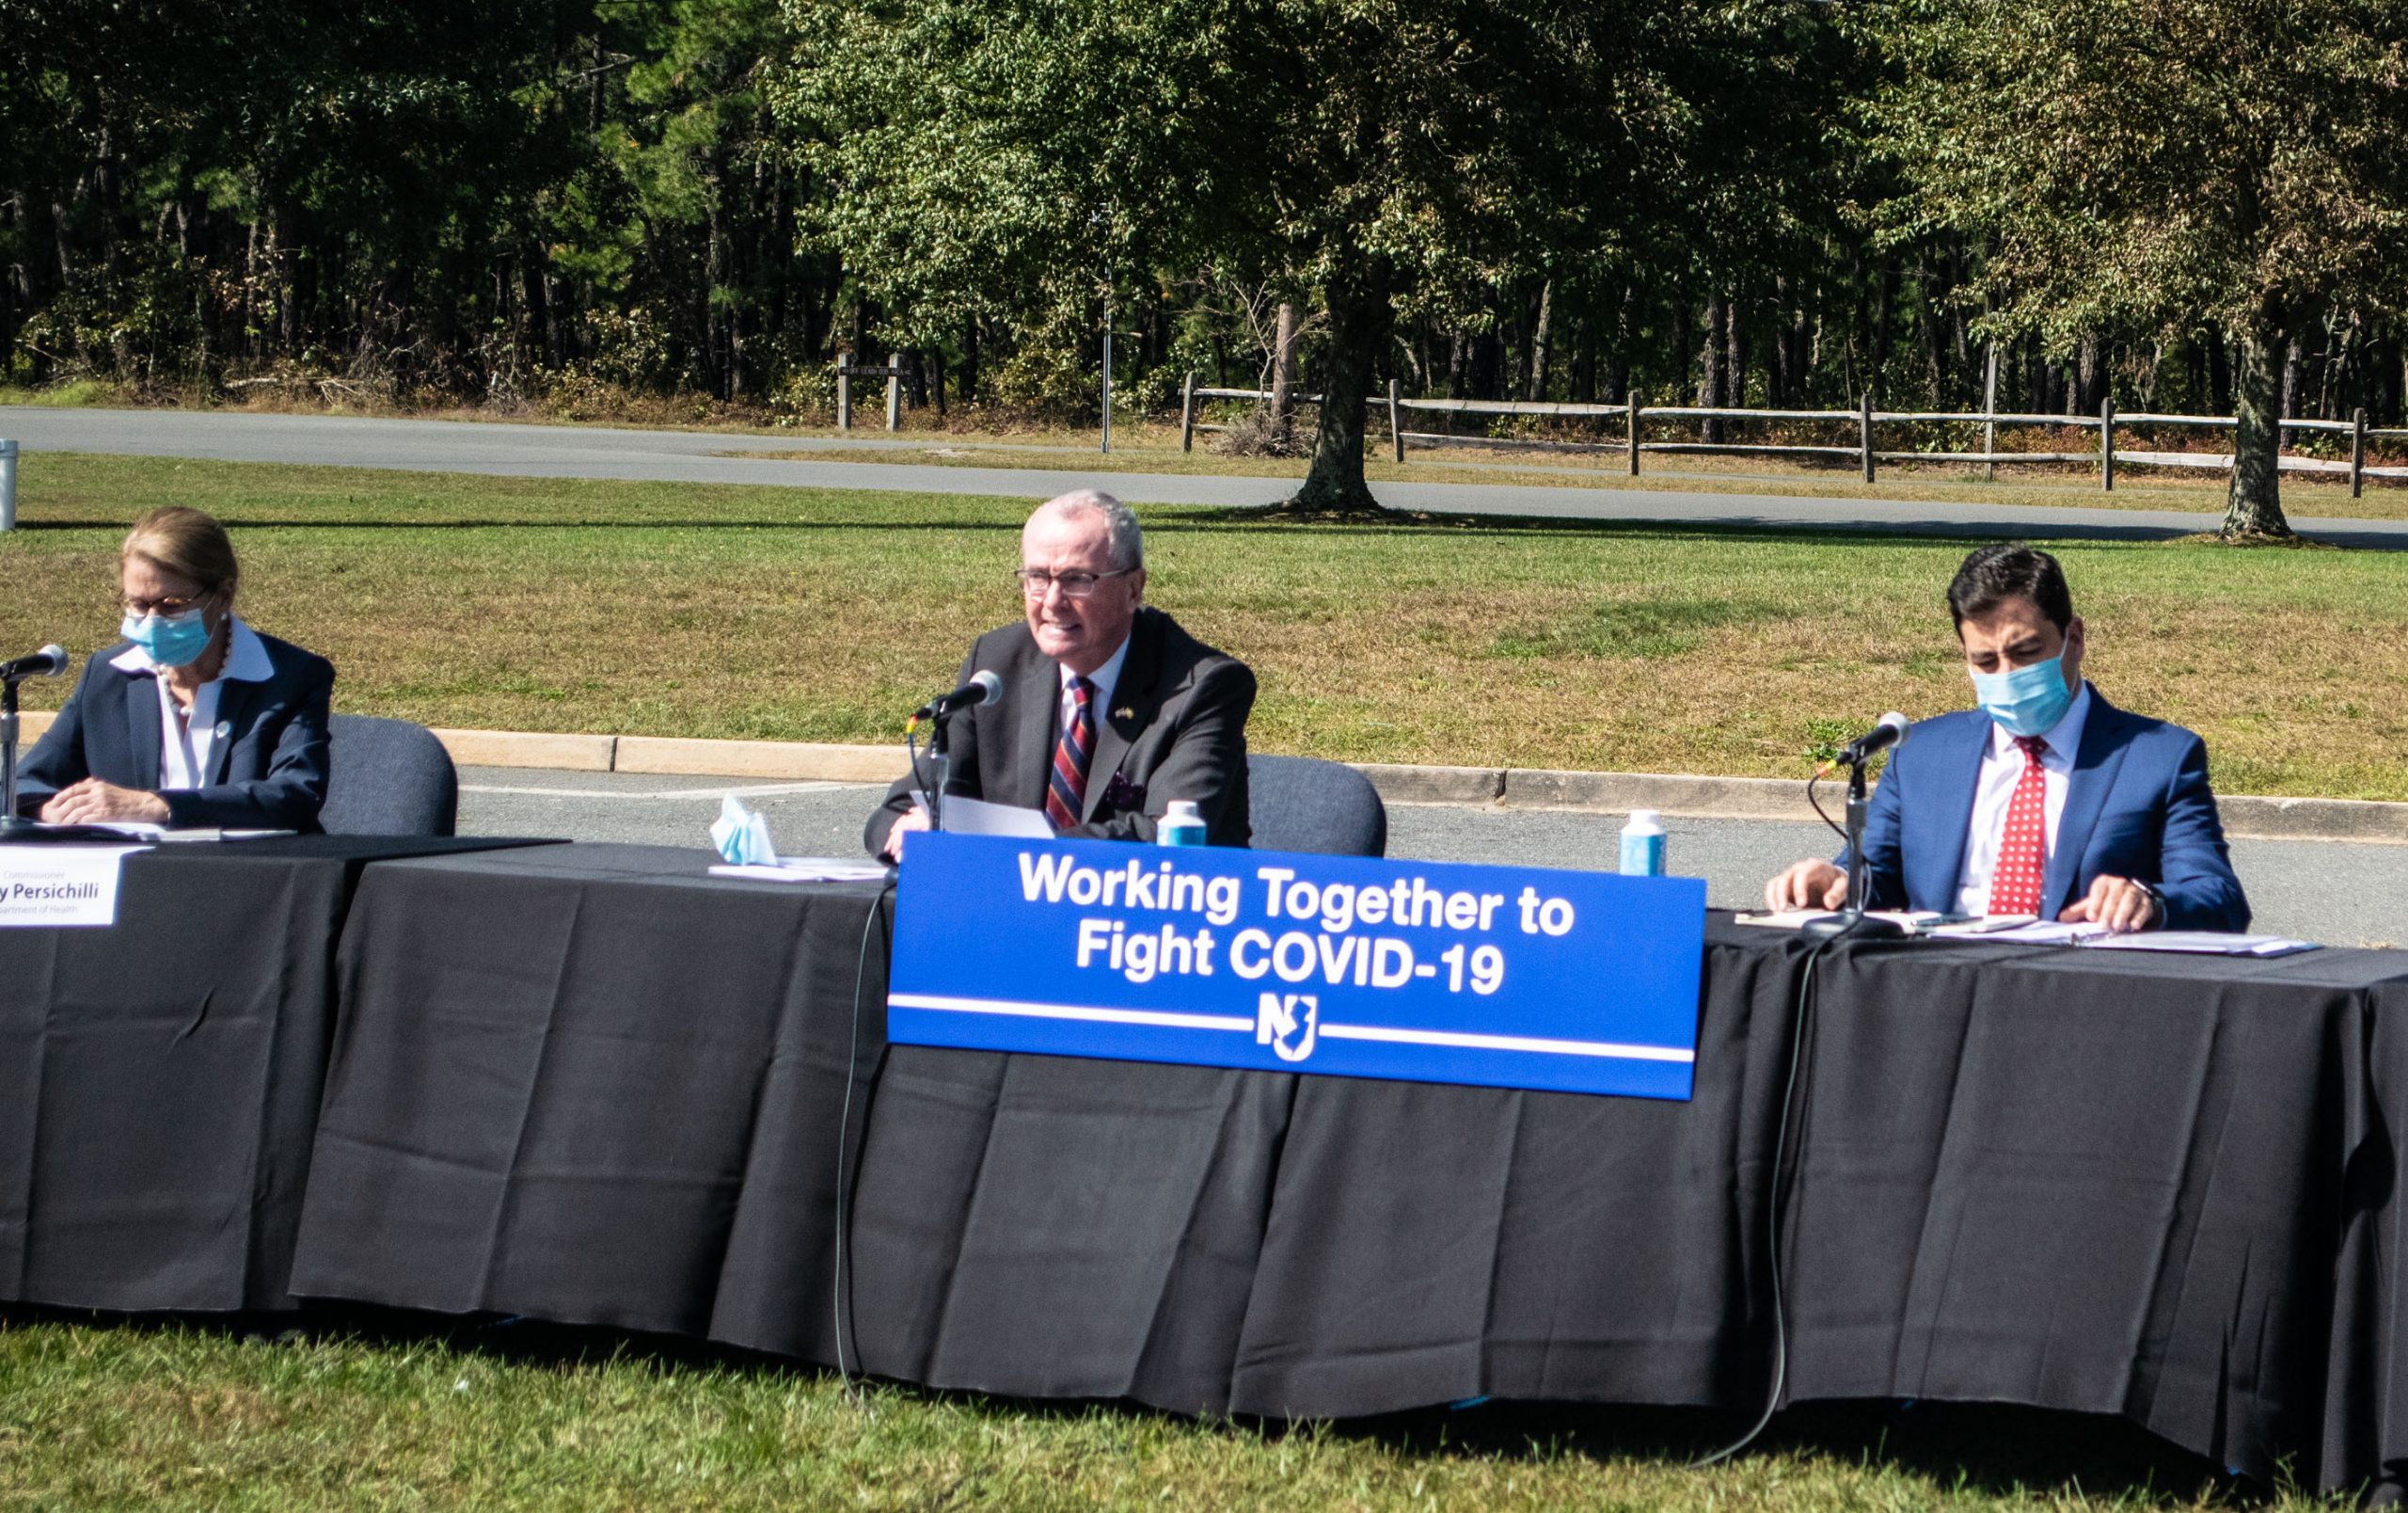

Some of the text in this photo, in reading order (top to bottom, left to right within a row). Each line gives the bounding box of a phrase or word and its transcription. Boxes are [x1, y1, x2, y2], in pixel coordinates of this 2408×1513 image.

[3, 870, 65, 879] Commissioner
[13, 883, 99, 899] Persichilli
[1019, 852, 1575, 936] Working Together to
[39, 904, 48, 913] of
[50, 904, 77, 913] Health
[1077, 918, 1504, 995] Fight COVID-19
[1257, 993, 1317, 1061] NJ
